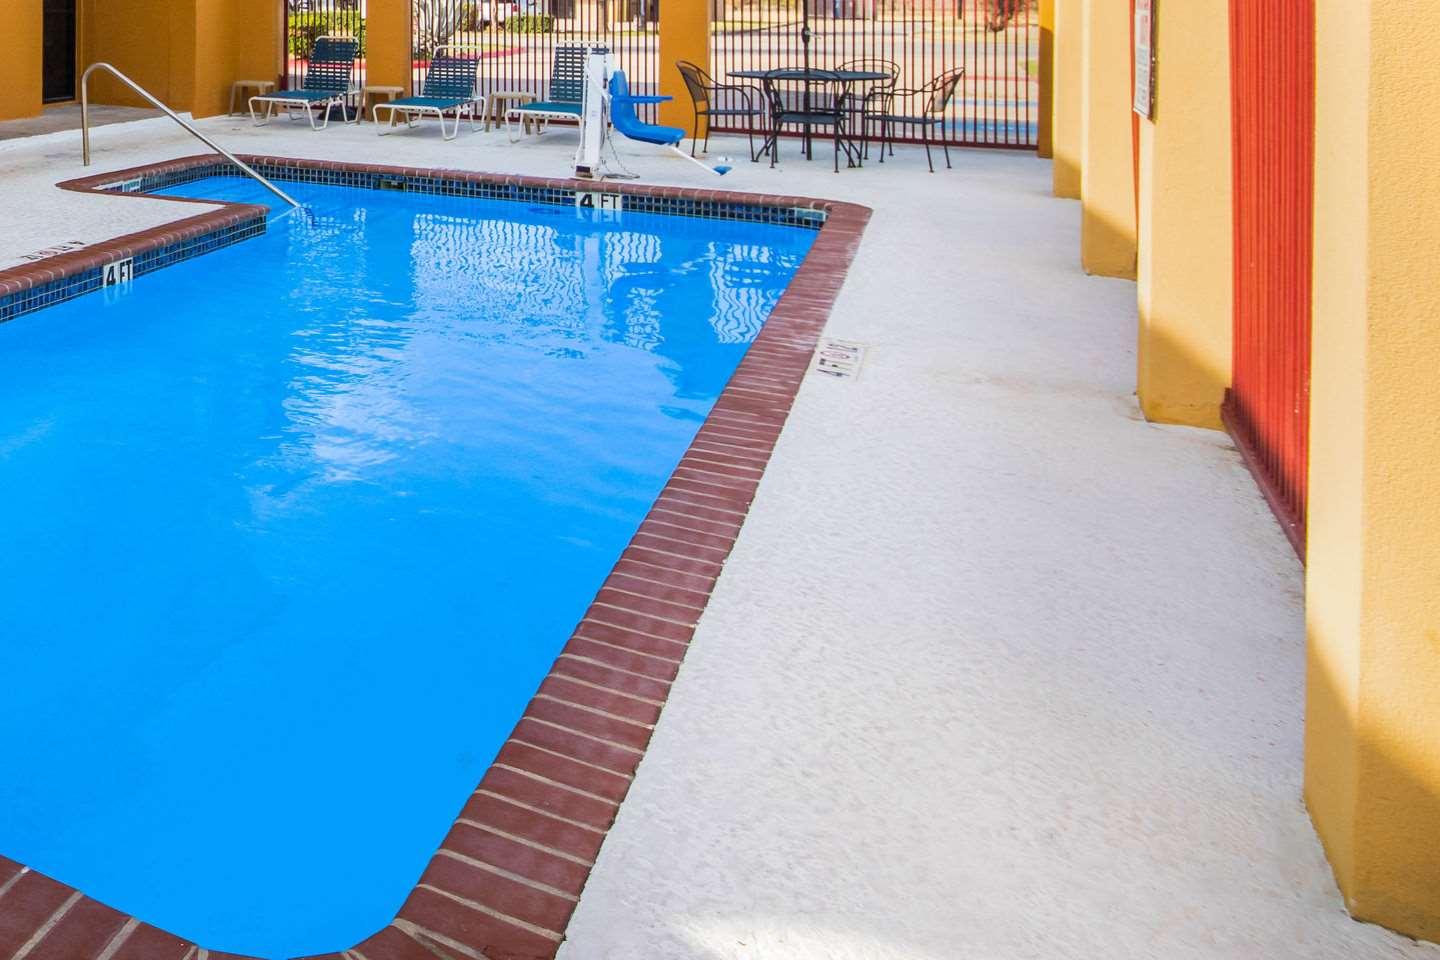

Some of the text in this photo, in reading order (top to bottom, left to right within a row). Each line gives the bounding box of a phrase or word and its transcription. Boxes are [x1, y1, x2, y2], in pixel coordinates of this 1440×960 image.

[580, 193, 620, 209] 4 FT
[106, 259, 133, 287] 4 FT
